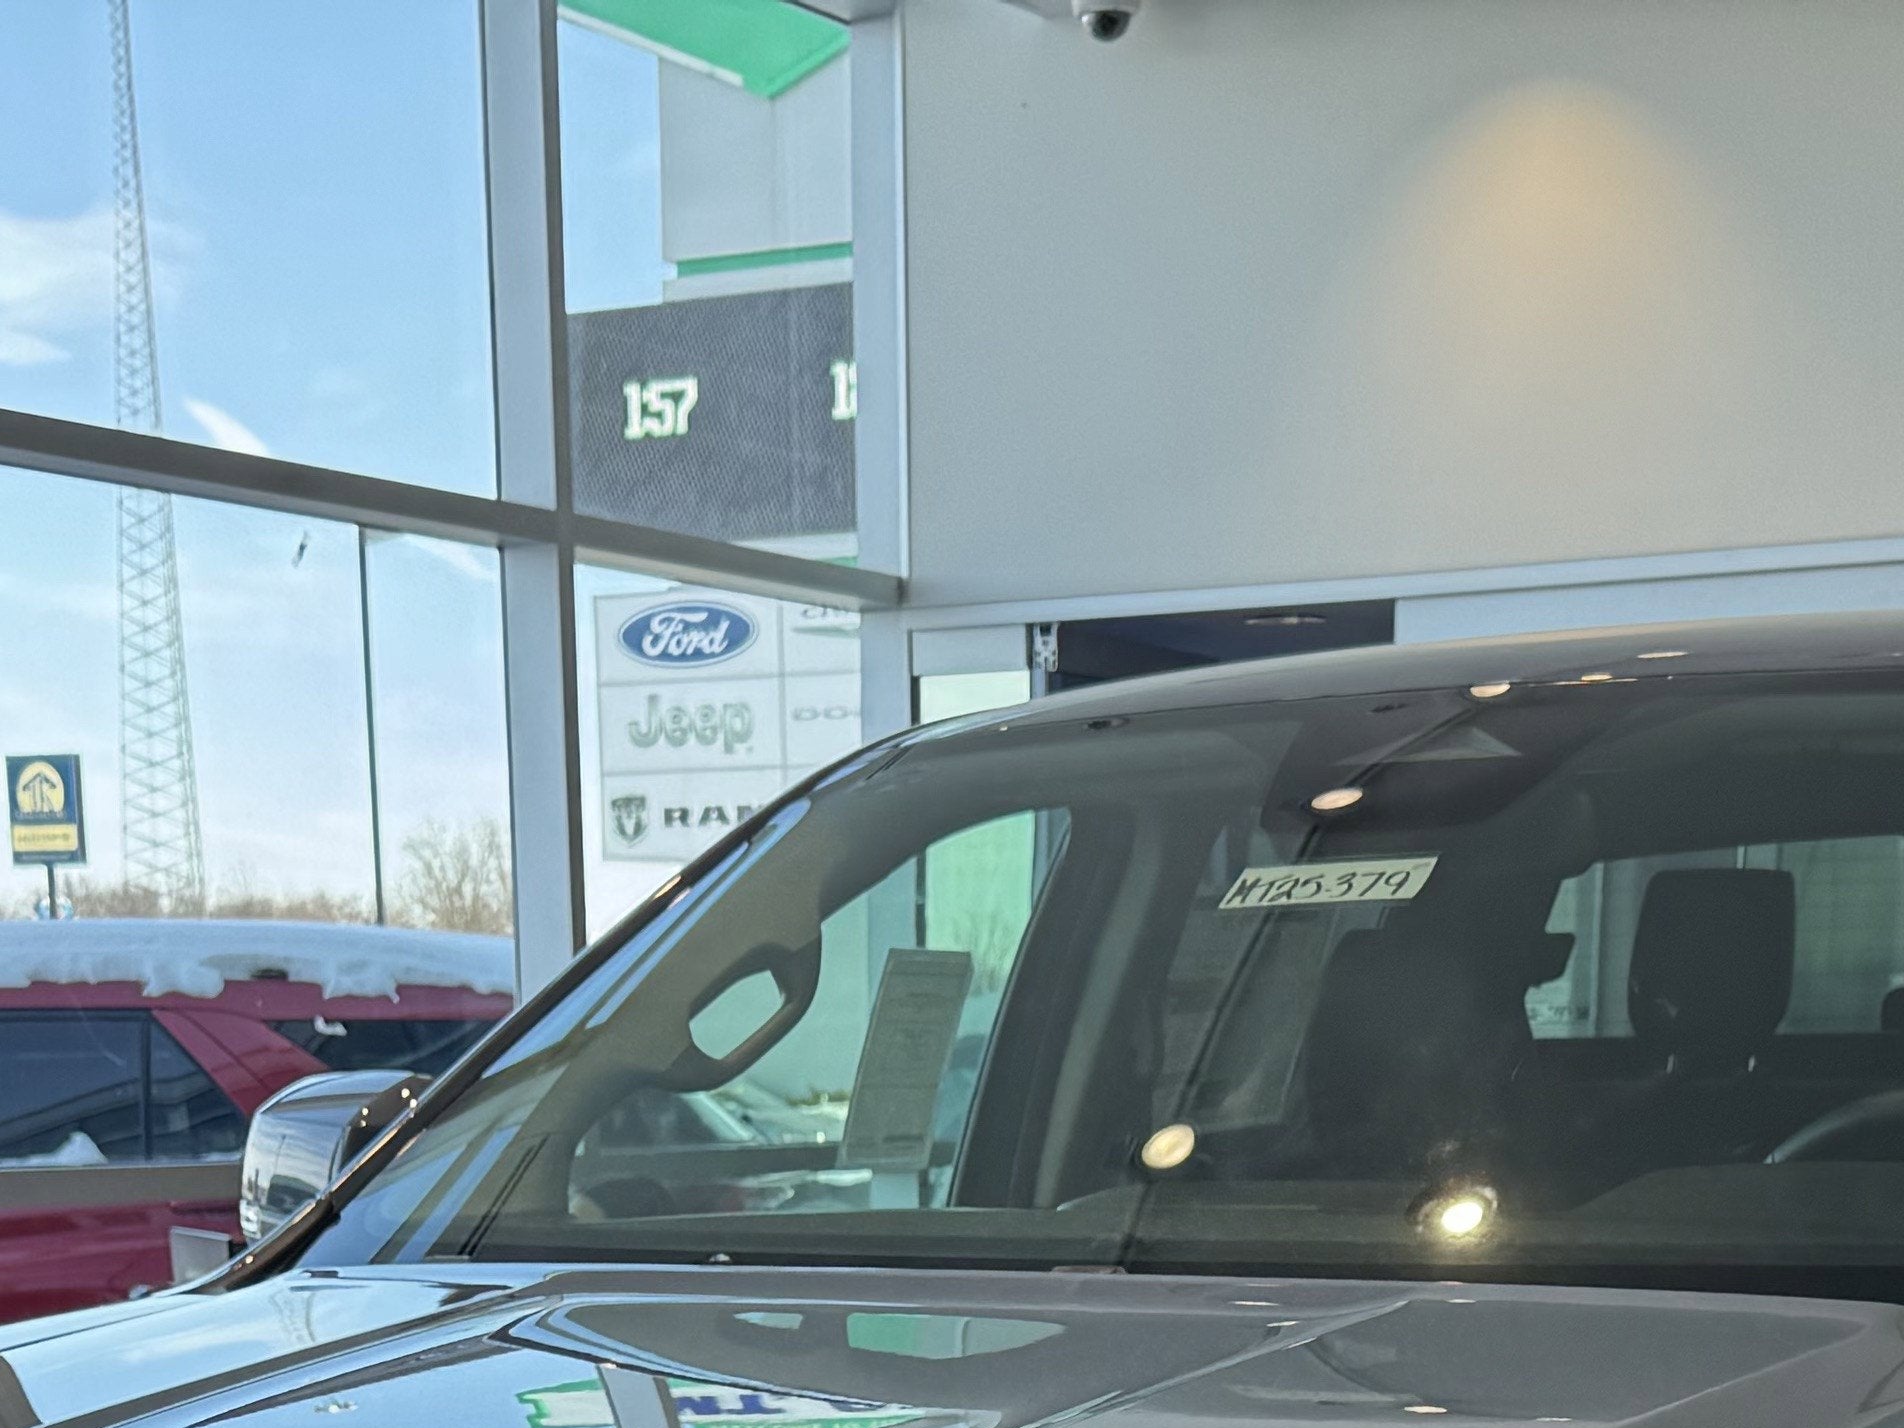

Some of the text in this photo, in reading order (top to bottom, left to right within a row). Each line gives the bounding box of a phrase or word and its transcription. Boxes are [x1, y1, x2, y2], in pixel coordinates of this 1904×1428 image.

[623, 376, 698, 440] 157
[641, 610, 730, 660] Ford
[627, 694, 755, 755] Jeep
